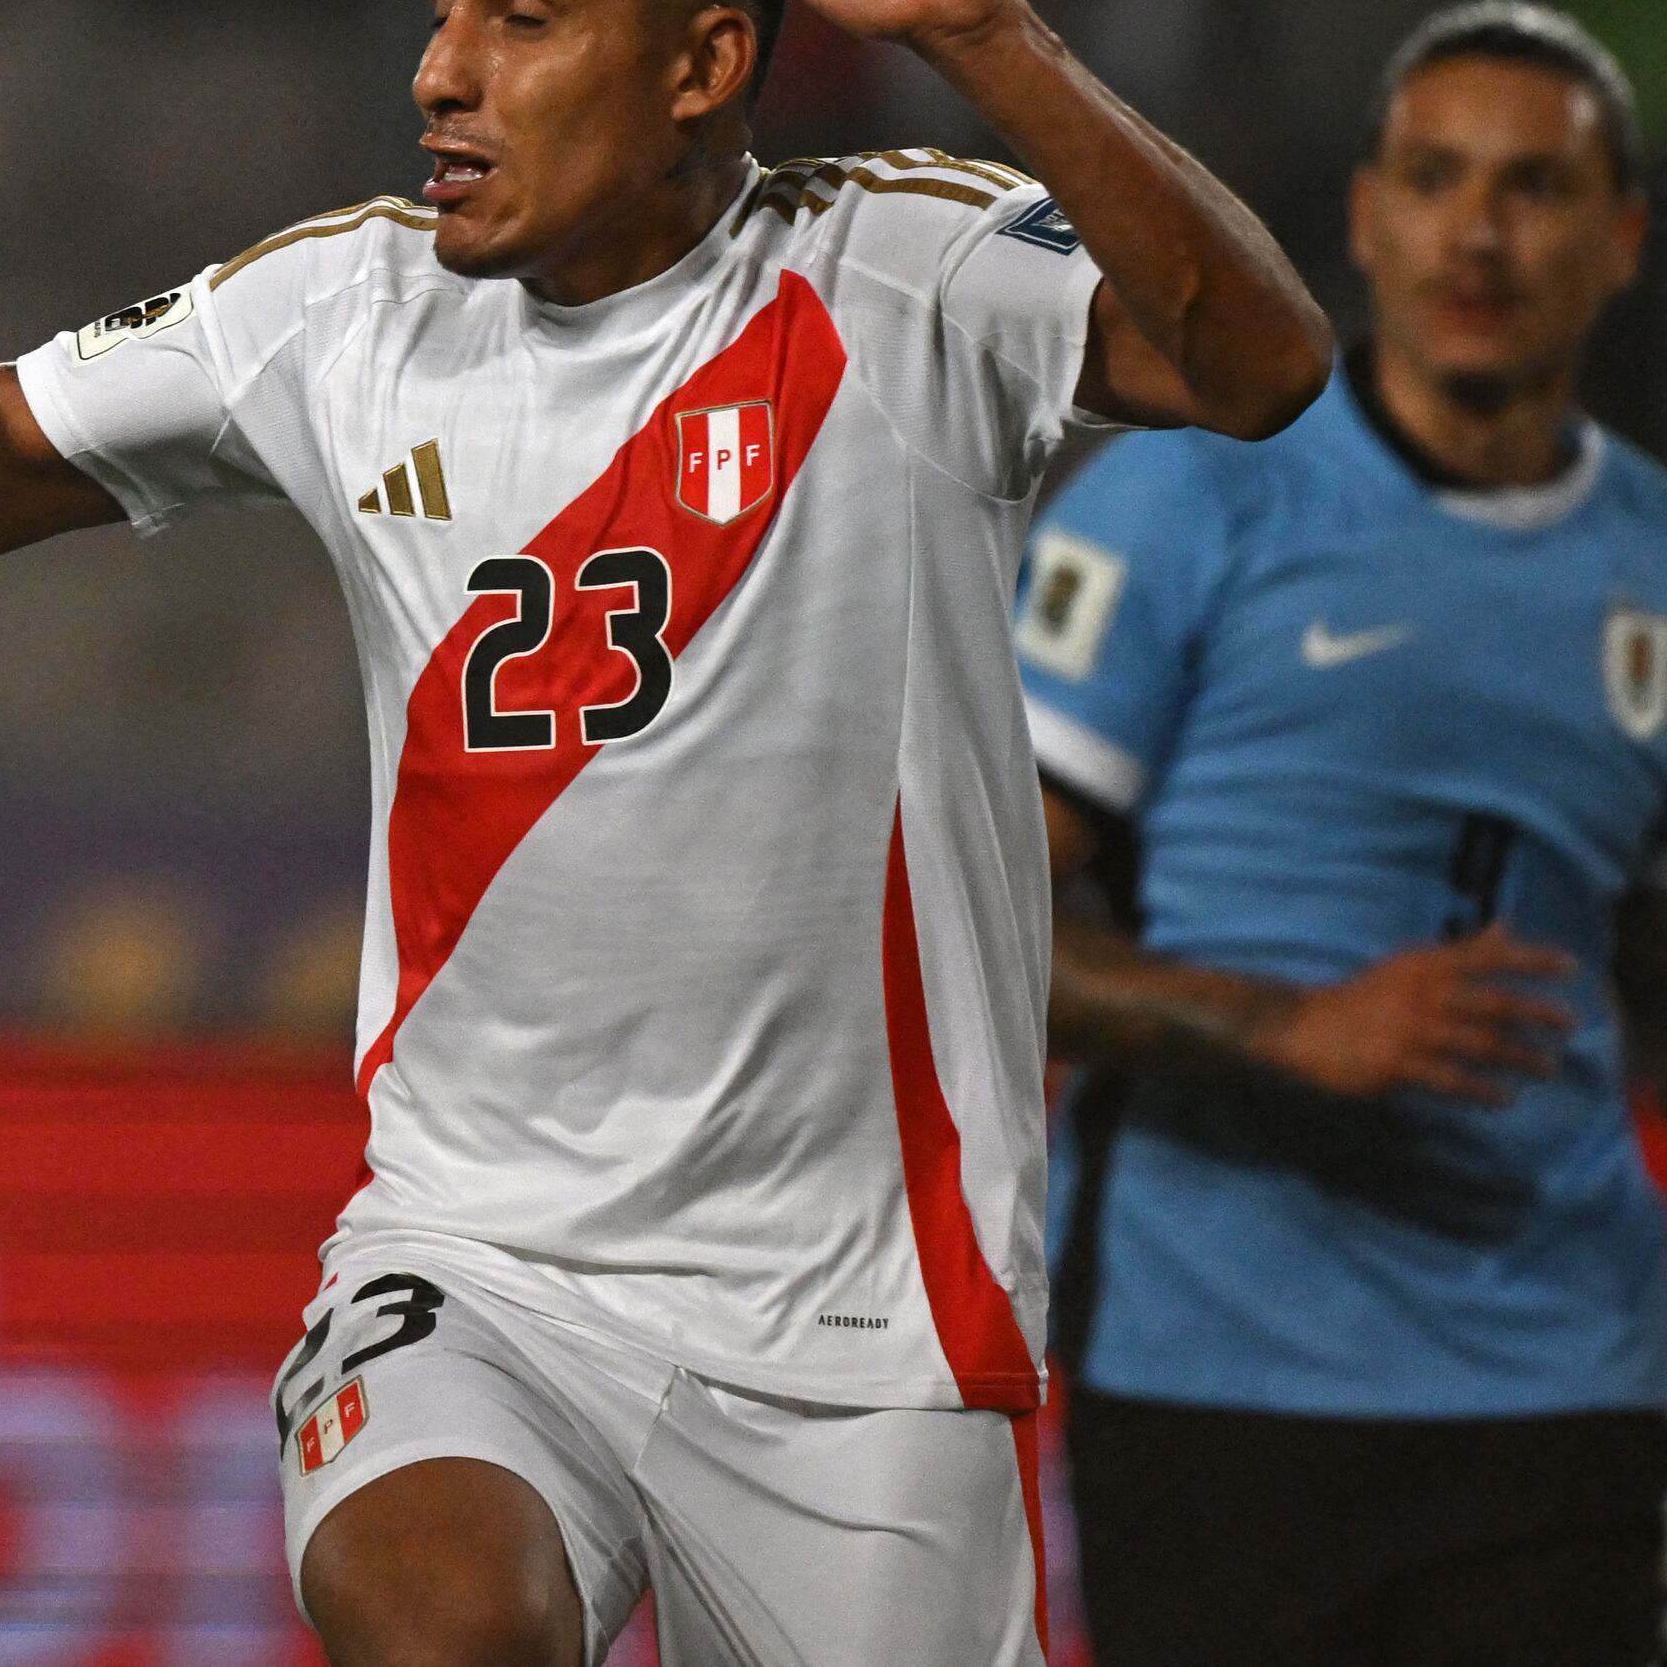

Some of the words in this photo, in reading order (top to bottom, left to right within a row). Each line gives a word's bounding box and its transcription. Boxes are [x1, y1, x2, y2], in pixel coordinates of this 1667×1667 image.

[461, 545, 675, 753] 23
[274, 1271, 445, 1462] 23
[818, 1314, 889, 1330] AEROREADY
